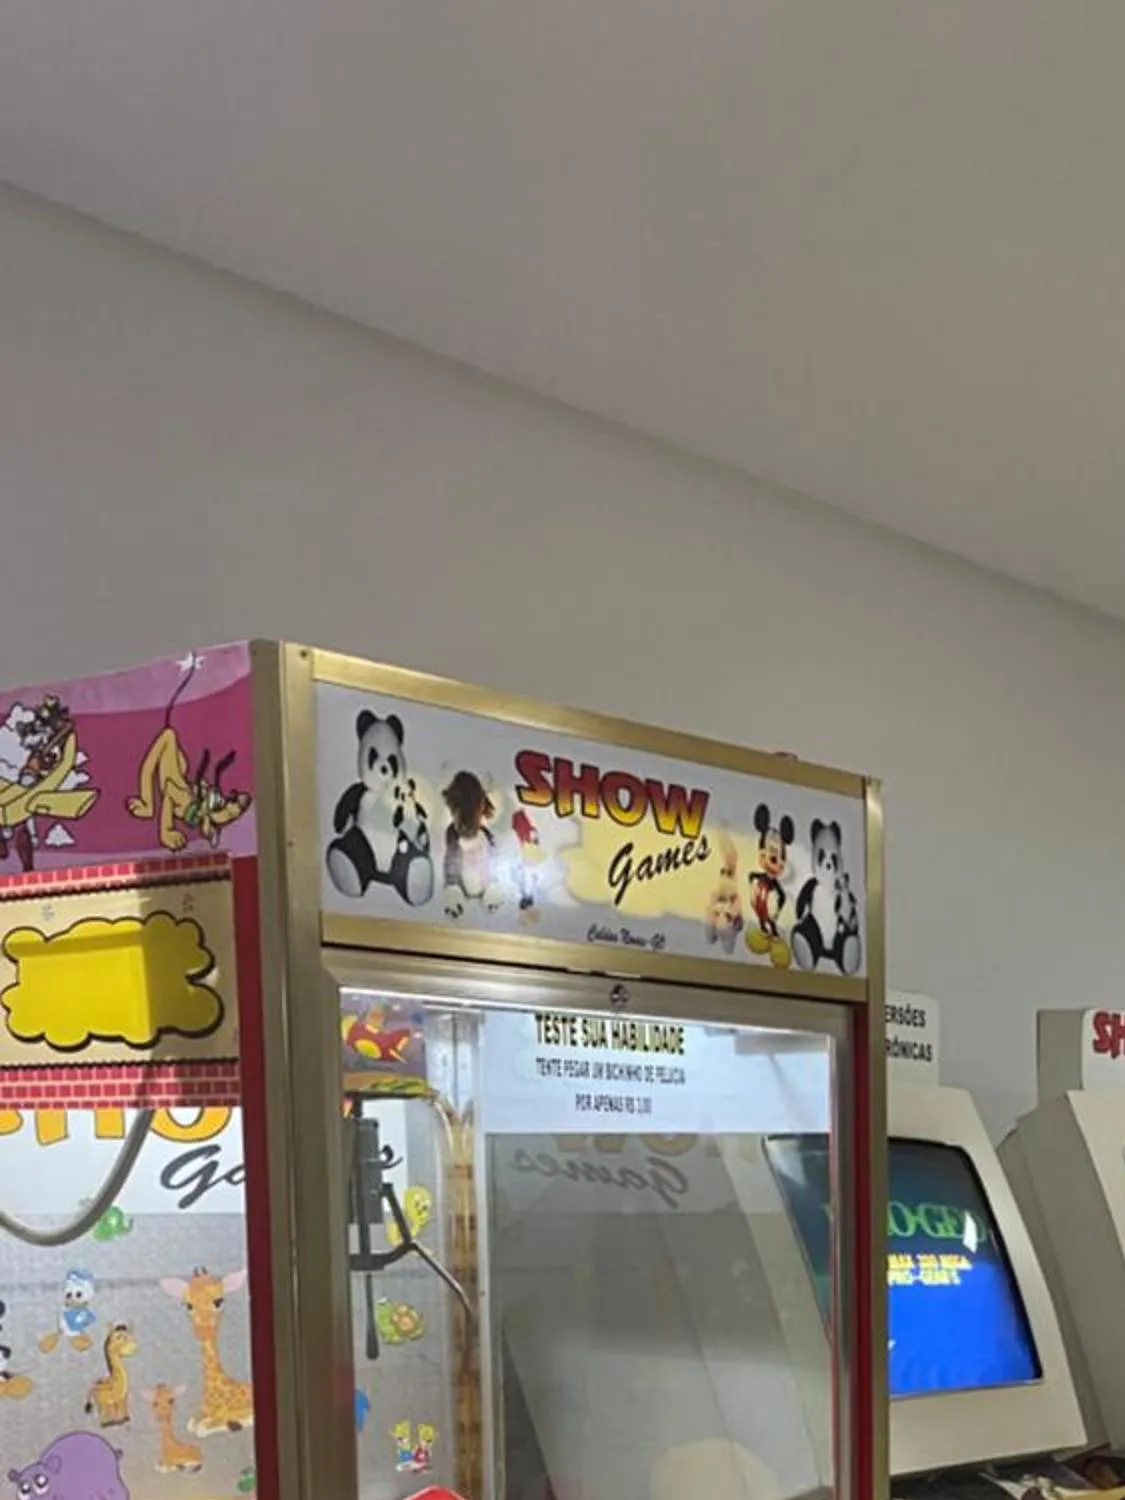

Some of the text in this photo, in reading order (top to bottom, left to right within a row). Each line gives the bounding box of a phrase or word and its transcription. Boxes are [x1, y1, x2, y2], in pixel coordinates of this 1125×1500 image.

[514, 750, 710, 839] SHOW
[608, 835, 711, 906] Games
[535, 1013, 685, 1056] TESTE SUA HABILIDADE
[885, 1003, 927, 1028] ERSÕES
